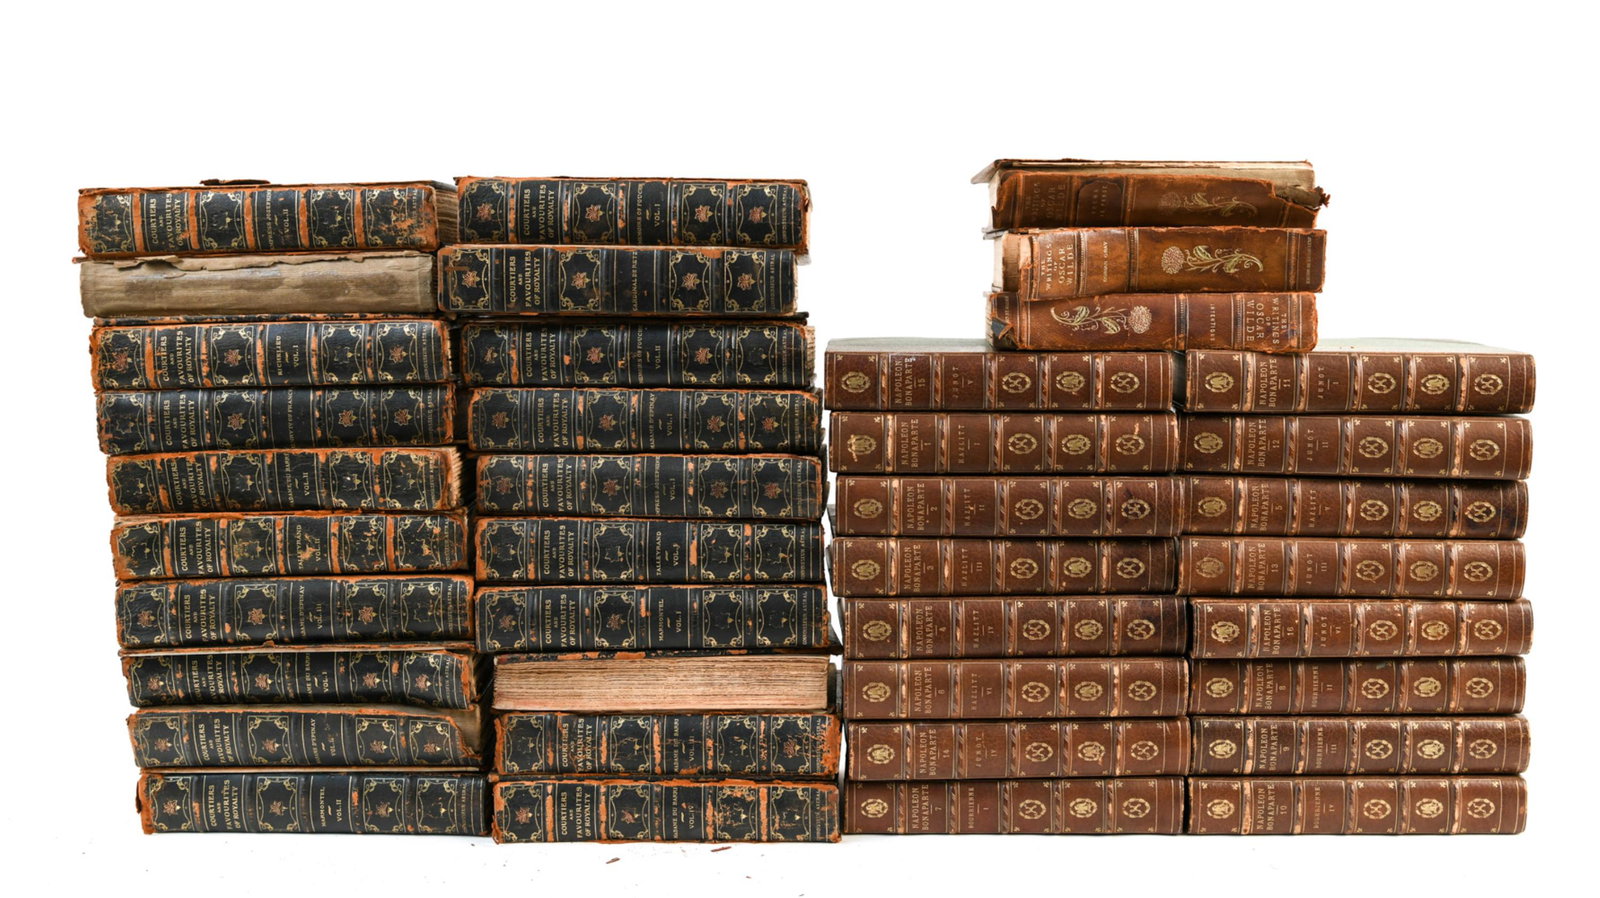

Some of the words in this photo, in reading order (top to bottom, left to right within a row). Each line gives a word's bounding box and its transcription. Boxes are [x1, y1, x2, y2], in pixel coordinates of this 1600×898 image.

[150, 199, 158, 243] COURTIERS
[166, 194, 175, 248] FAVOURITES
[1256, 303, 1264, 338] OSCAR
[160, 336, 169, 381] COURTIERS
[177, 331, 186, 384] FAVOURITES
[918, 378, 925, 387] 15
[1269, 359, 1277, 407] BONAPARTE
[164, 400, 172, 445] COURTIERS
[180, 395, 188, 448] FAVOURITES
[1273, 440, 1279, 448] 12
[171, 462, 183, 505] COURTIERS
[195, 463, 205, 495] ROYALTY
[1250, 485, 1259, 528] NAPOLEON
[1260, 483, 1269, 530] BONAPARTE
[180, 527, 188, 571] COURTIERS
[196, 521, 204, 574] FAVOURITES
[200, 589, 208, 641] FAVOURITES
[1272, 608, 1280, 654] BONAPARTE
[1287, 627, 1294, 635] 16
[216, 661, 224, 693] ROYALTY
[1265, 663, 1273, 709] BONAPARTE
[199, 724, 210, 760] COURTIERS
[214, 719, 226, 763] FAVOURITES
[223, 725, 232, 754] ROYALTY
[1259, 728, 1267, 768] NAPOLEON
[1269, 725, 1277, 770] BONAPARTE
[208, 785, 217, 826] COURTIERS
[223, 780, 232, 829] FAVOURITES
[1280, 806, 1287, 814] 10
